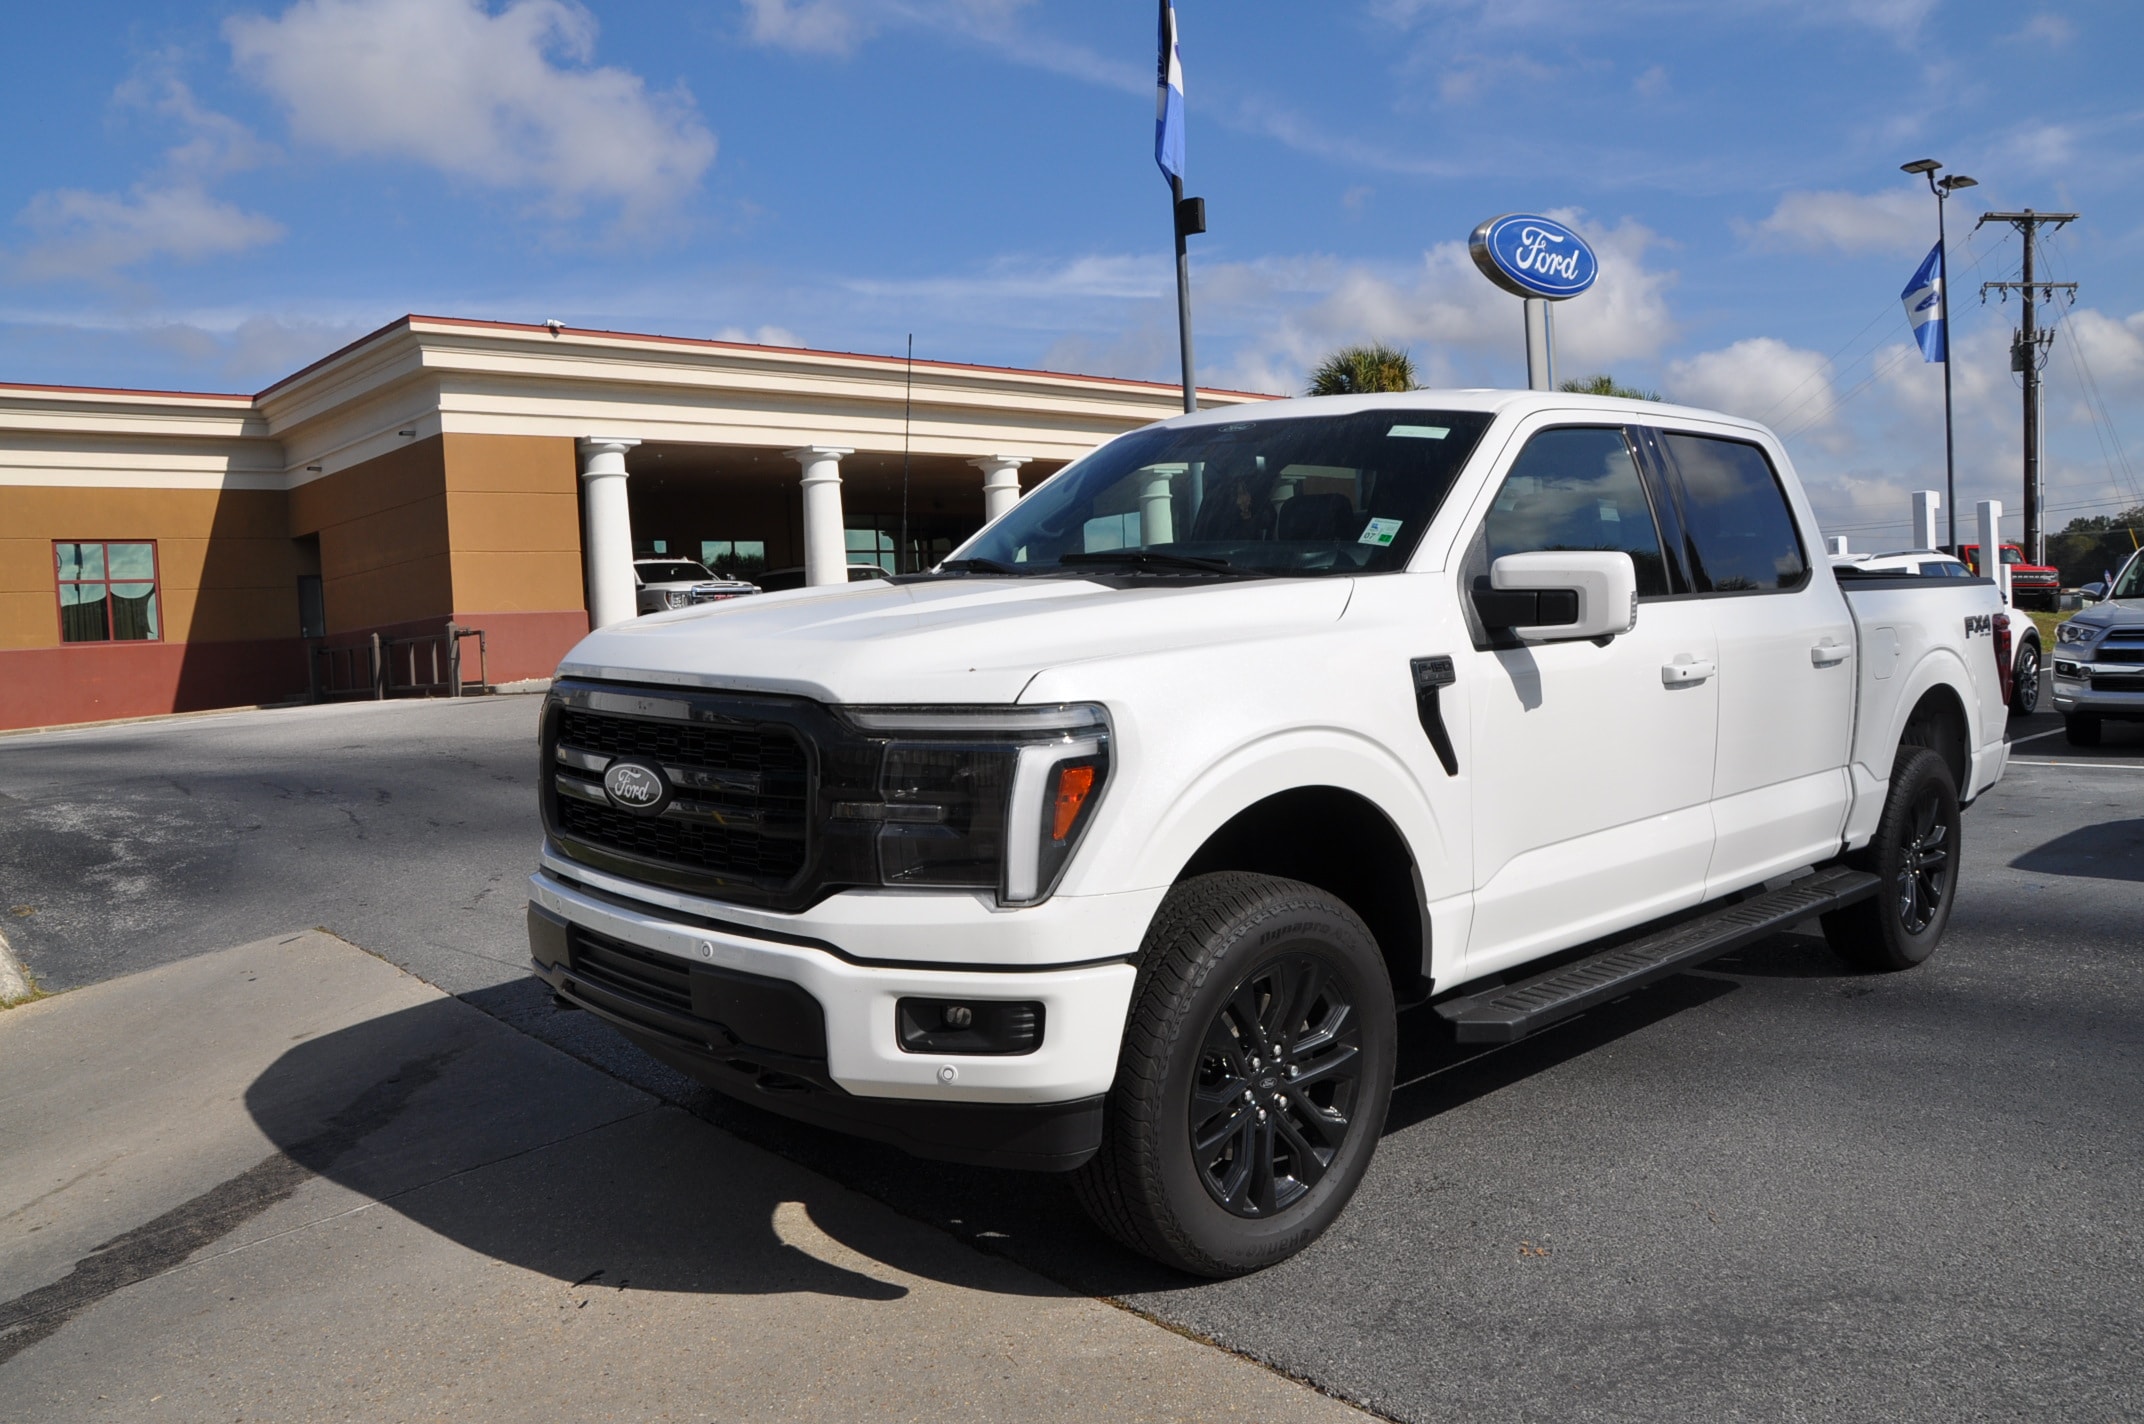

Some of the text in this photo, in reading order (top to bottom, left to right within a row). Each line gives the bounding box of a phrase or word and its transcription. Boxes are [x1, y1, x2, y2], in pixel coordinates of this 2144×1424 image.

[1516, 226, 1580, 280] Ford
[1964, 614, 1991, 639] FX4
[615, 769, 650, 801] Ford
[1259, 921, 1331, 946] Dynapro
